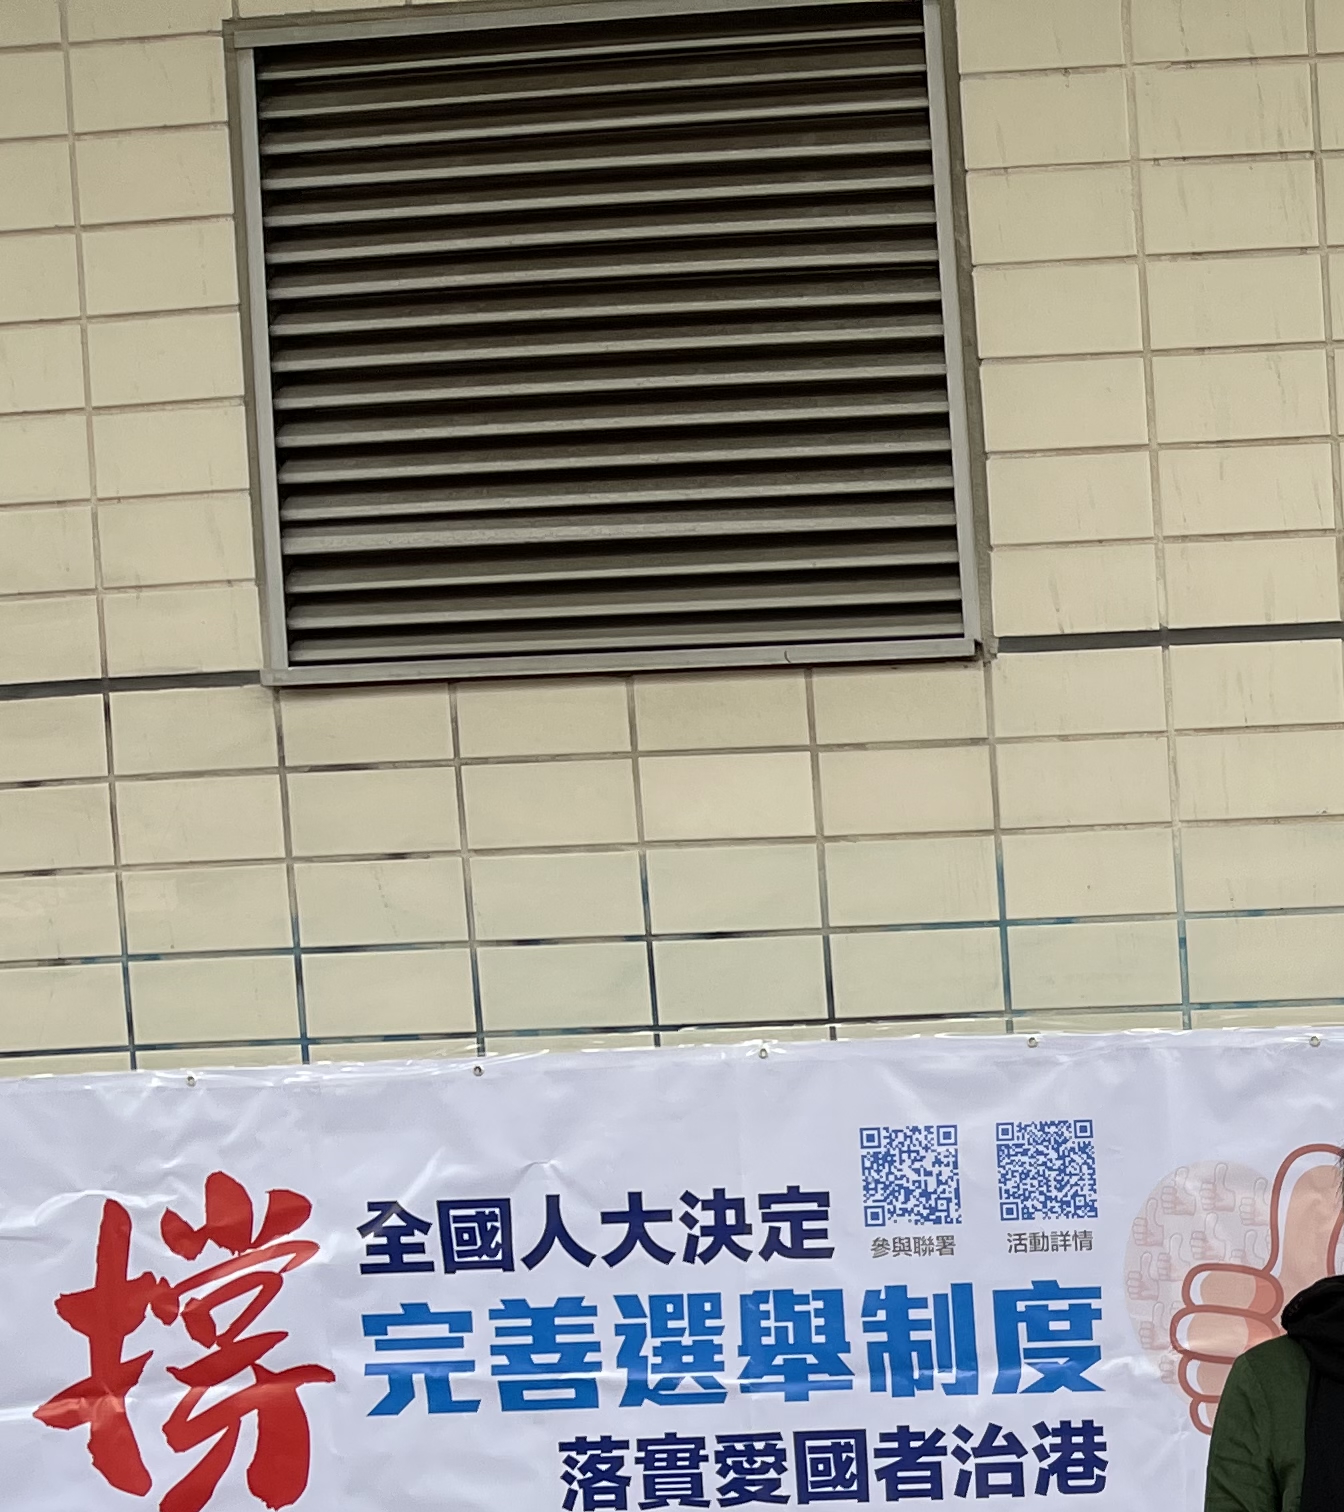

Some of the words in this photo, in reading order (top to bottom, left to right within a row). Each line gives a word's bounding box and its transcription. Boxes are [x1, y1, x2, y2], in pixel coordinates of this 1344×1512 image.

[357, 1185, 835, 1275] 全國人大決定
[870, 1236, 957, 1259] 參與聯署
[1006, 1230, 1094, 1255] 活動詳情
[361, 1280, 1106, 1417] 完善選舉制度
[558, 1418, 1109, 1512] 落實愛國者治港
